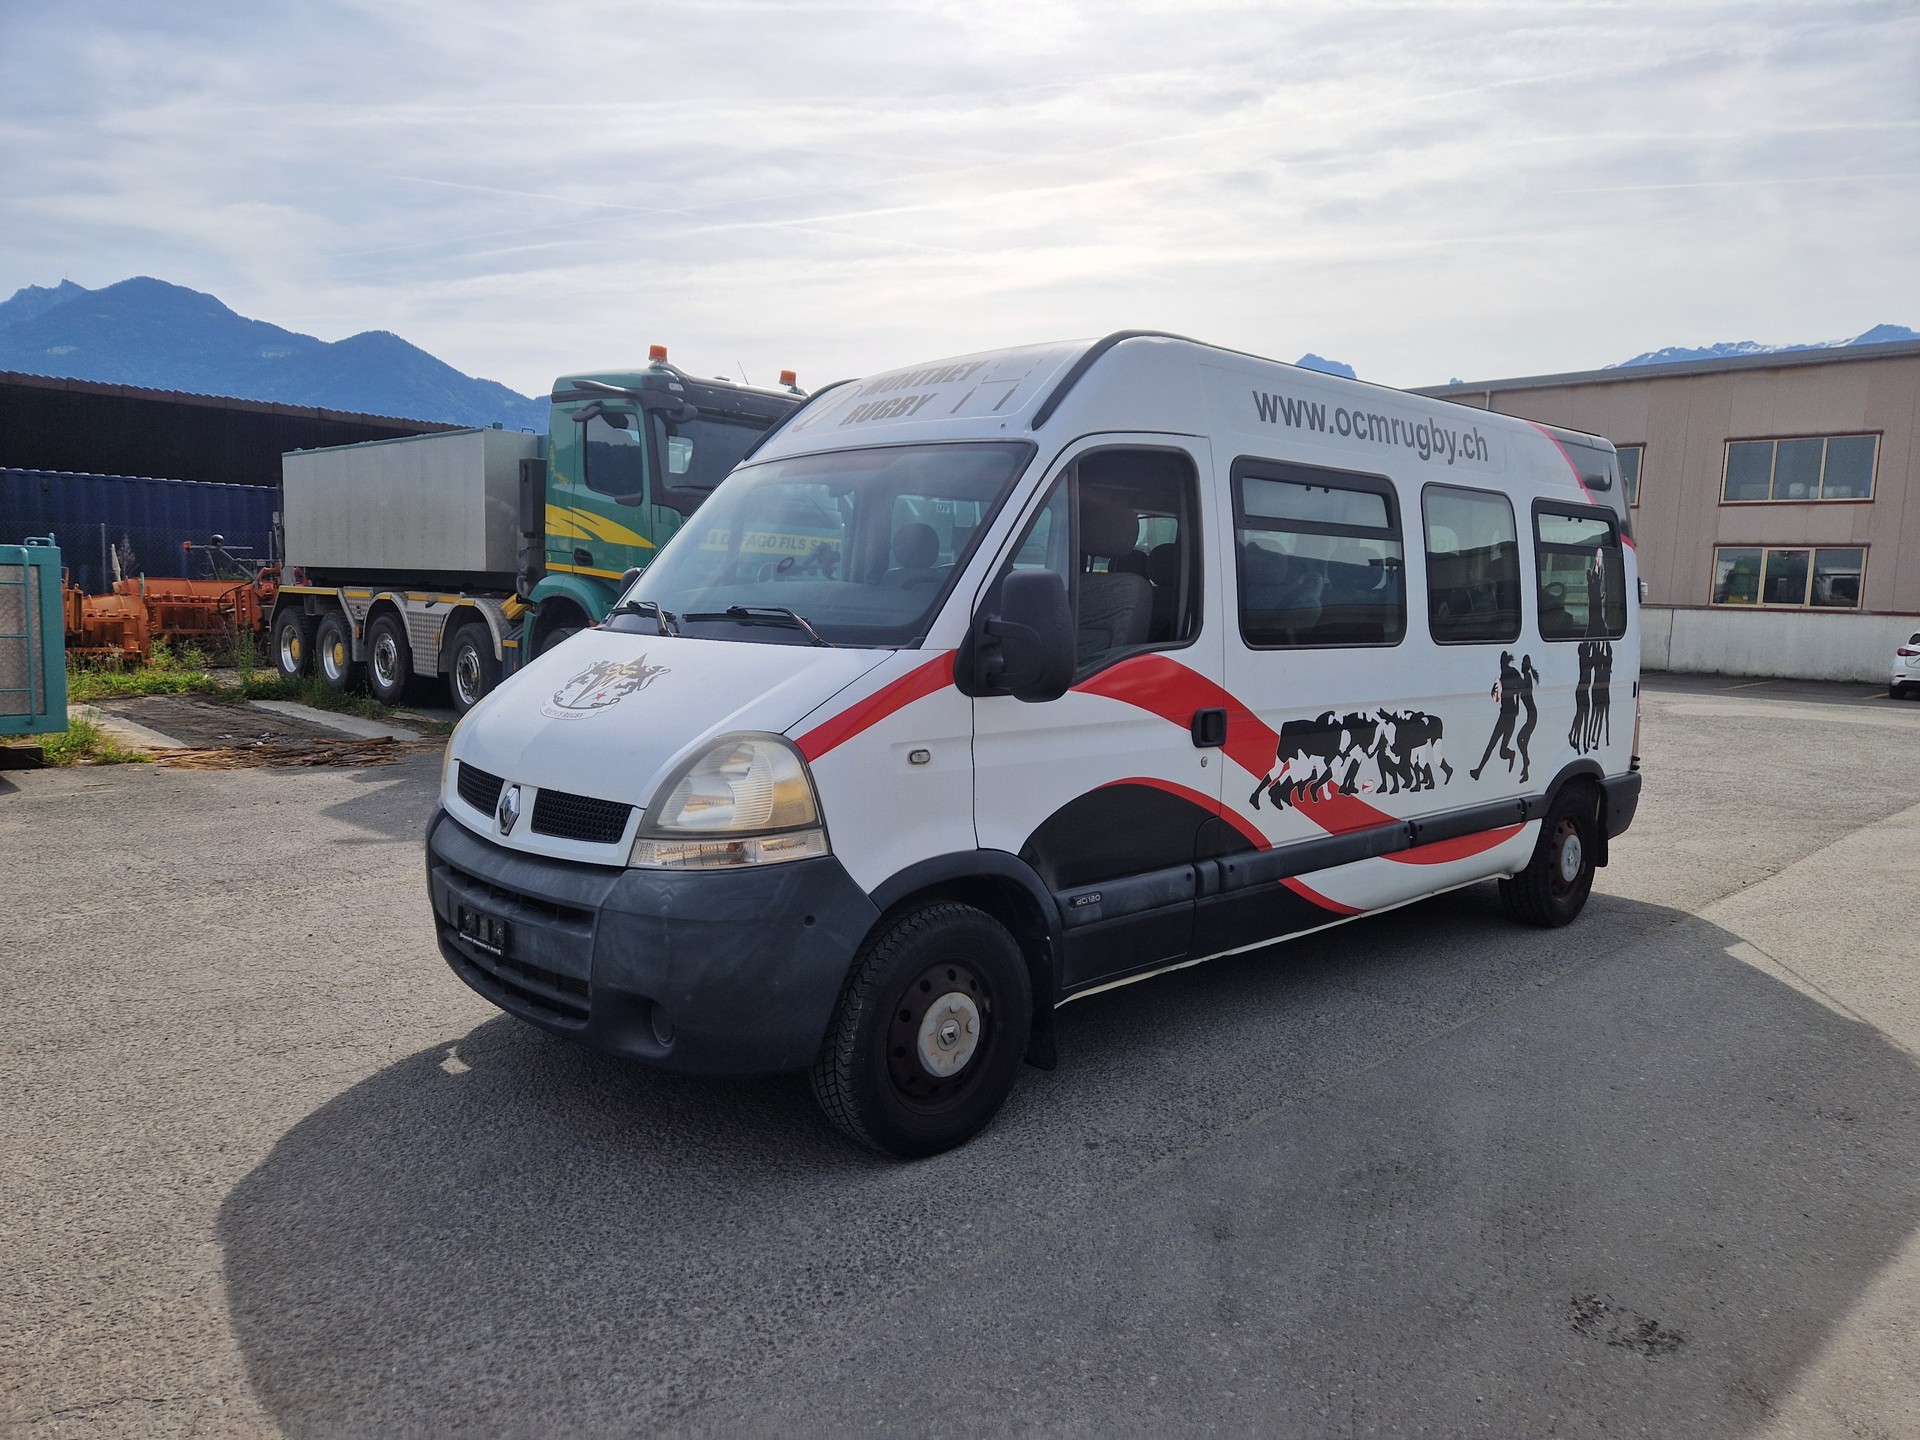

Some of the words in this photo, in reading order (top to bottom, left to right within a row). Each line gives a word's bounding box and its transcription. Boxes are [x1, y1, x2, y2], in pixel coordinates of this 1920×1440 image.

[839, 393, 938, 426] RUGBY
[1252, 390, 1489, 465] www.ocmrugby.ch
[721, 533, 777, 548] DFAGO
[778, 536, 806, 550] FILS
